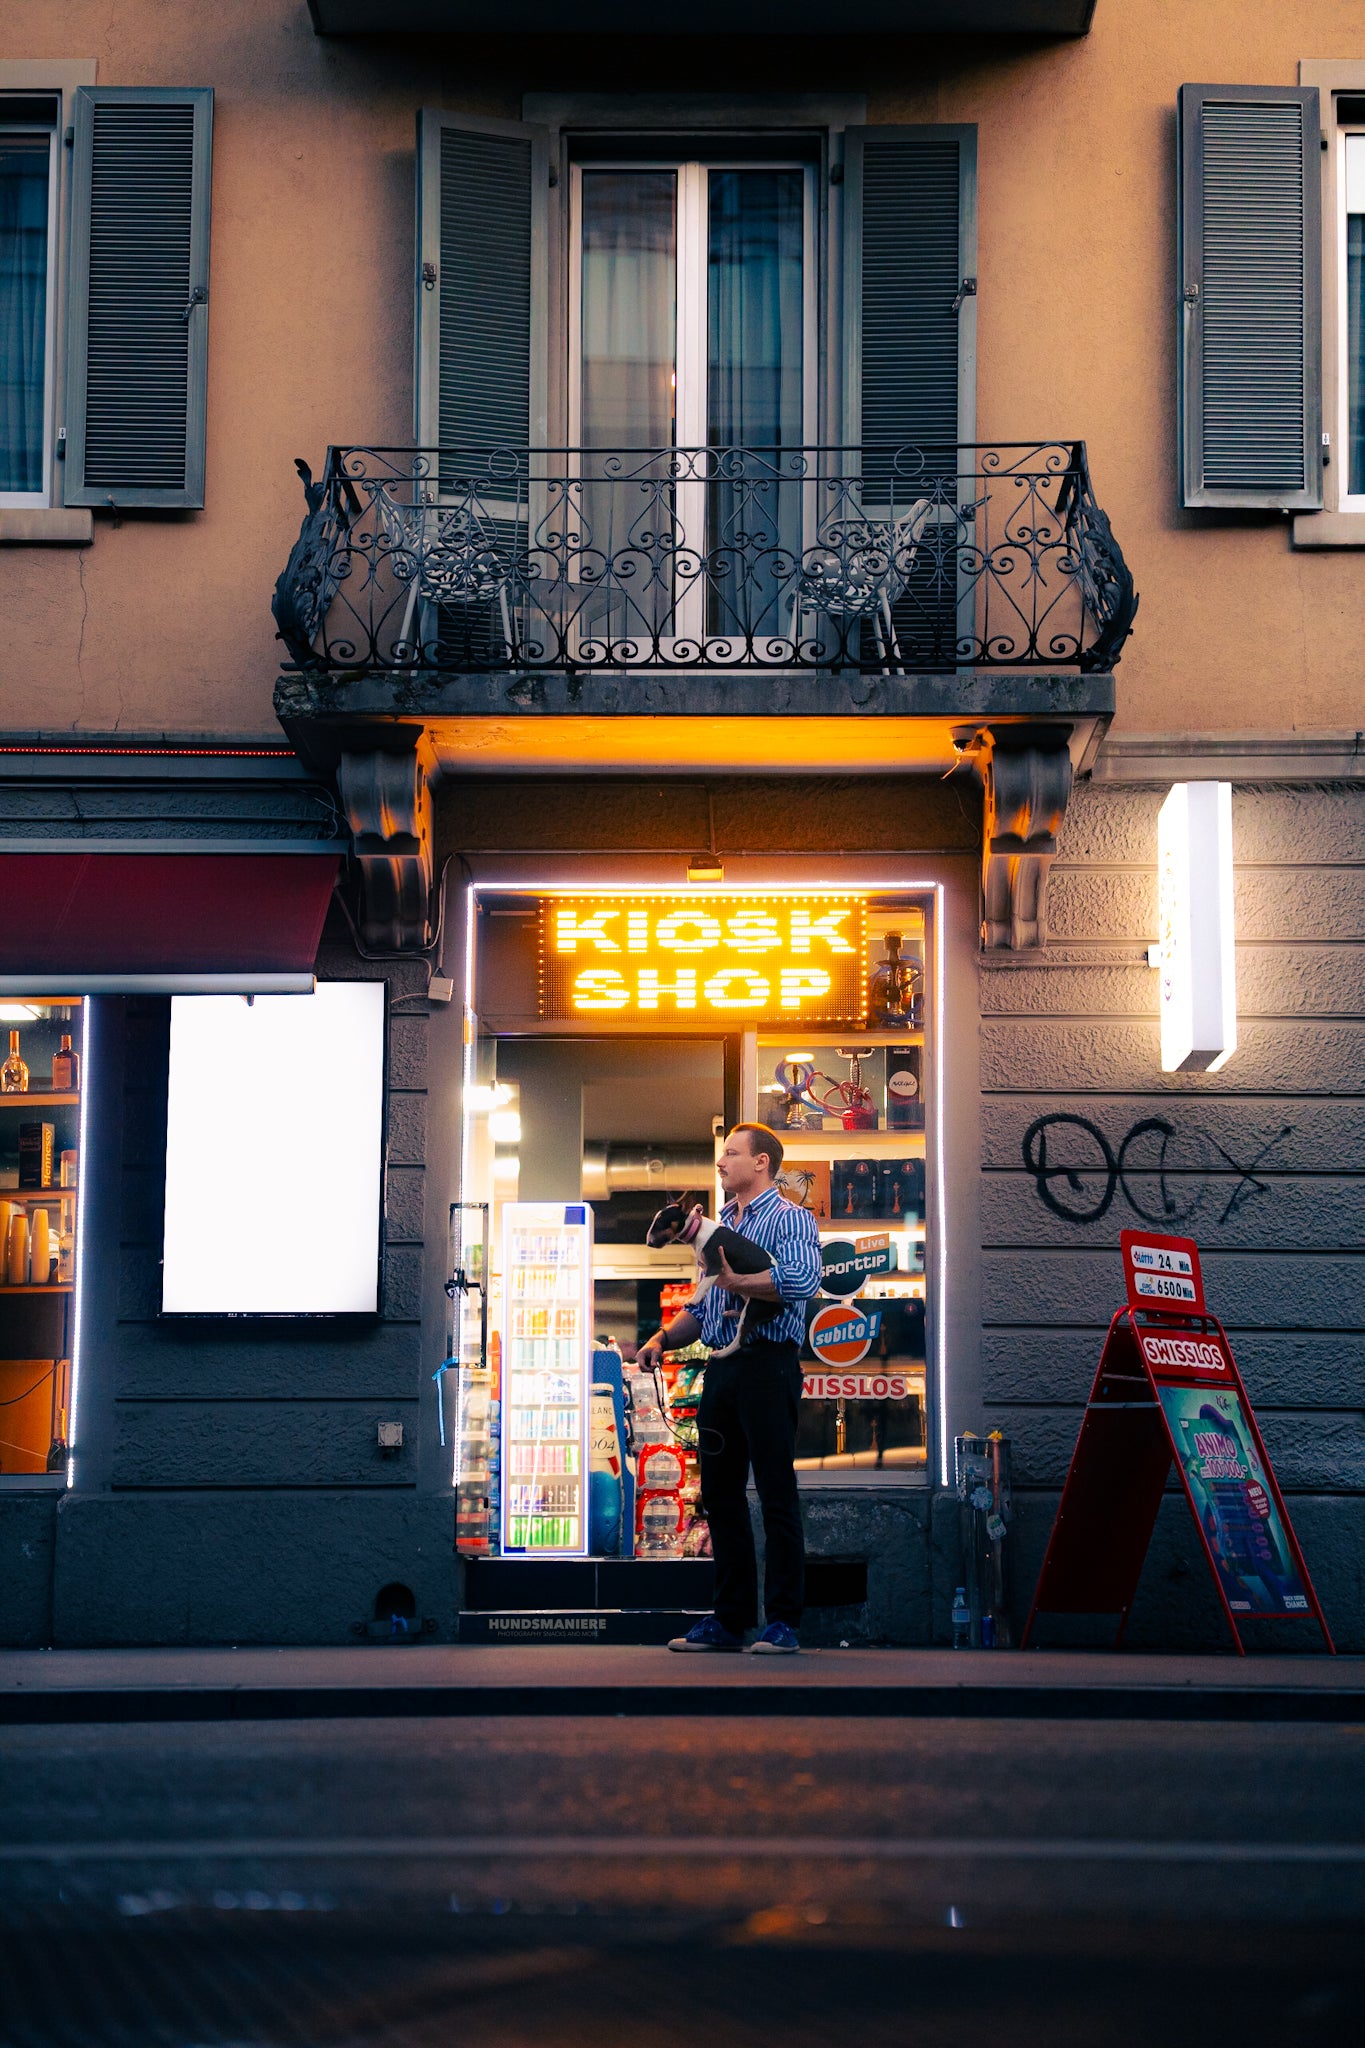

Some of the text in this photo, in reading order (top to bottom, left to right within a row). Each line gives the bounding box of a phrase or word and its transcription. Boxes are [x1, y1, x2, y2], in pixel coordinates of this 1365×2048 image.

[556, 910, 857, 953] KIOSK
[572, 968, 832, 1010] SHOP
[43, 1127, 53, 1187] Hennessy
[860, 1238, 886, 1250] Live
[1139, 1253, 1154, 1265] LOTTO
[1144, 1339, 1224, 1368] SWISSLOS
[591, 1406, 613, 1415] LANC
[1194, 1432, 1238, 1459] ANIMO
[1247, 1486, 1263, 1497] NEU
[1285, 1601, 1309, 1609] CHANCE
